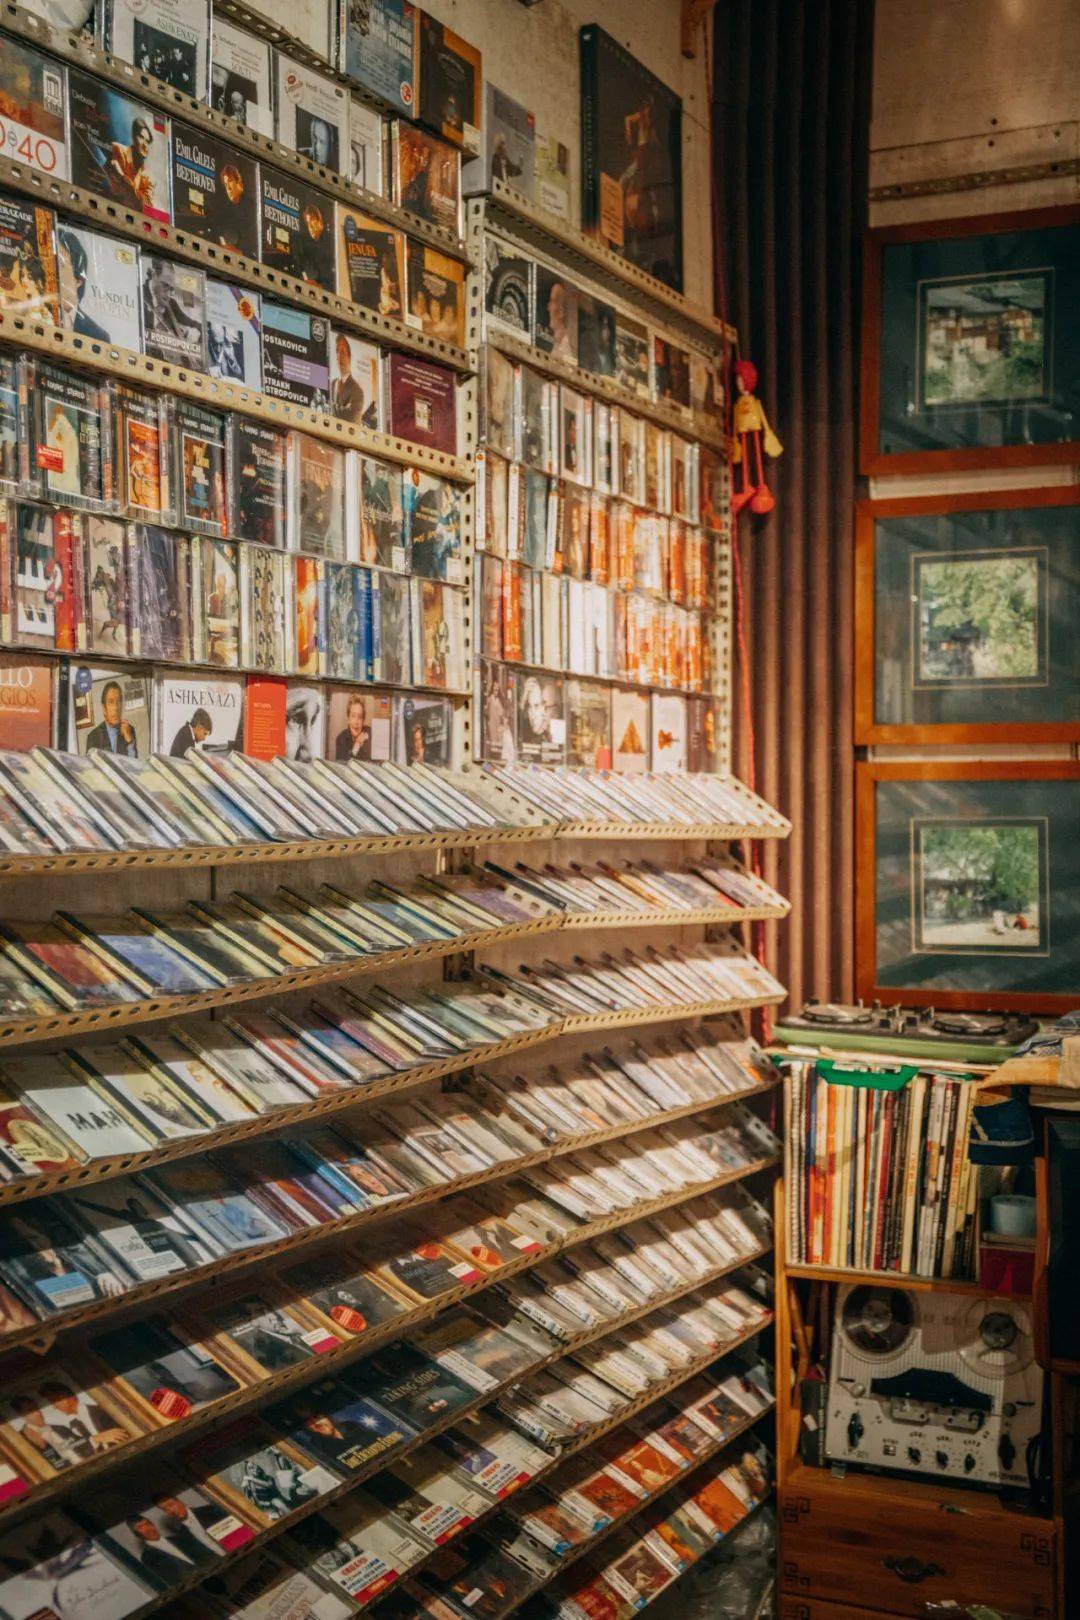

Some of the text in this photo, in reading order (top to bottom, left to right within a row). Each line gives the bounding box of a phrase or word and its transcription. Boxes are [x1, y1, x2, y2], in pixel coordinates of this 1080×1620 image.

[175, 137, 216, 172] EMIL GILELS
[176, 162, 216, 193] BEETHOVEN
[264, 180, 300, 210] EMIL GILELS
[264, 204, 300, 232] BEETHOVEN
[150, 331, 201, 353] ROSTROPOVICH
[167, 689, 236, 708] ASHKENAZY
